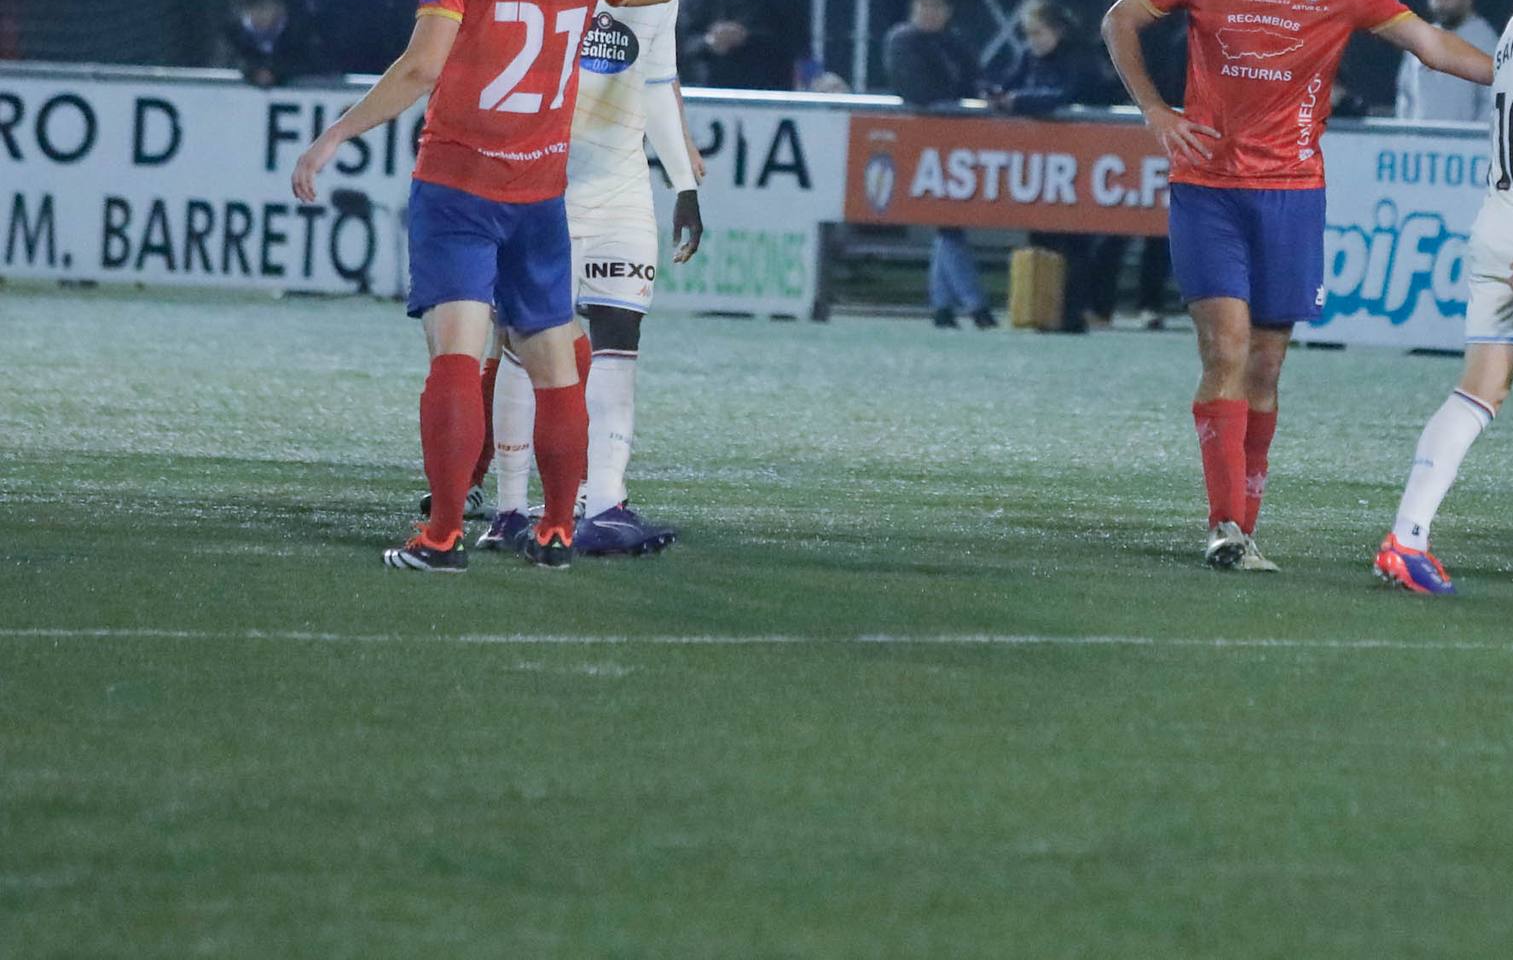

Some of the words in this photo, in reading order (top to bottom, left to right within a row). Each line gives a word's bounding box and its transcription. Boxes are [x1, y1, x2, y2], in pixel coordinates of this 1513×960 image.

[584, 28, 629, 47] strella
[1227, 13, 1301, 32] RECAMBIOS
[479, 1, 588, 113] 21
[1220, 63, 1293, 82] ASTURIAS
[132, 96, 182, 165] D
[908, 147, 1077, 204] ASTUR
[101, 195, 377, 280] BARRETO
